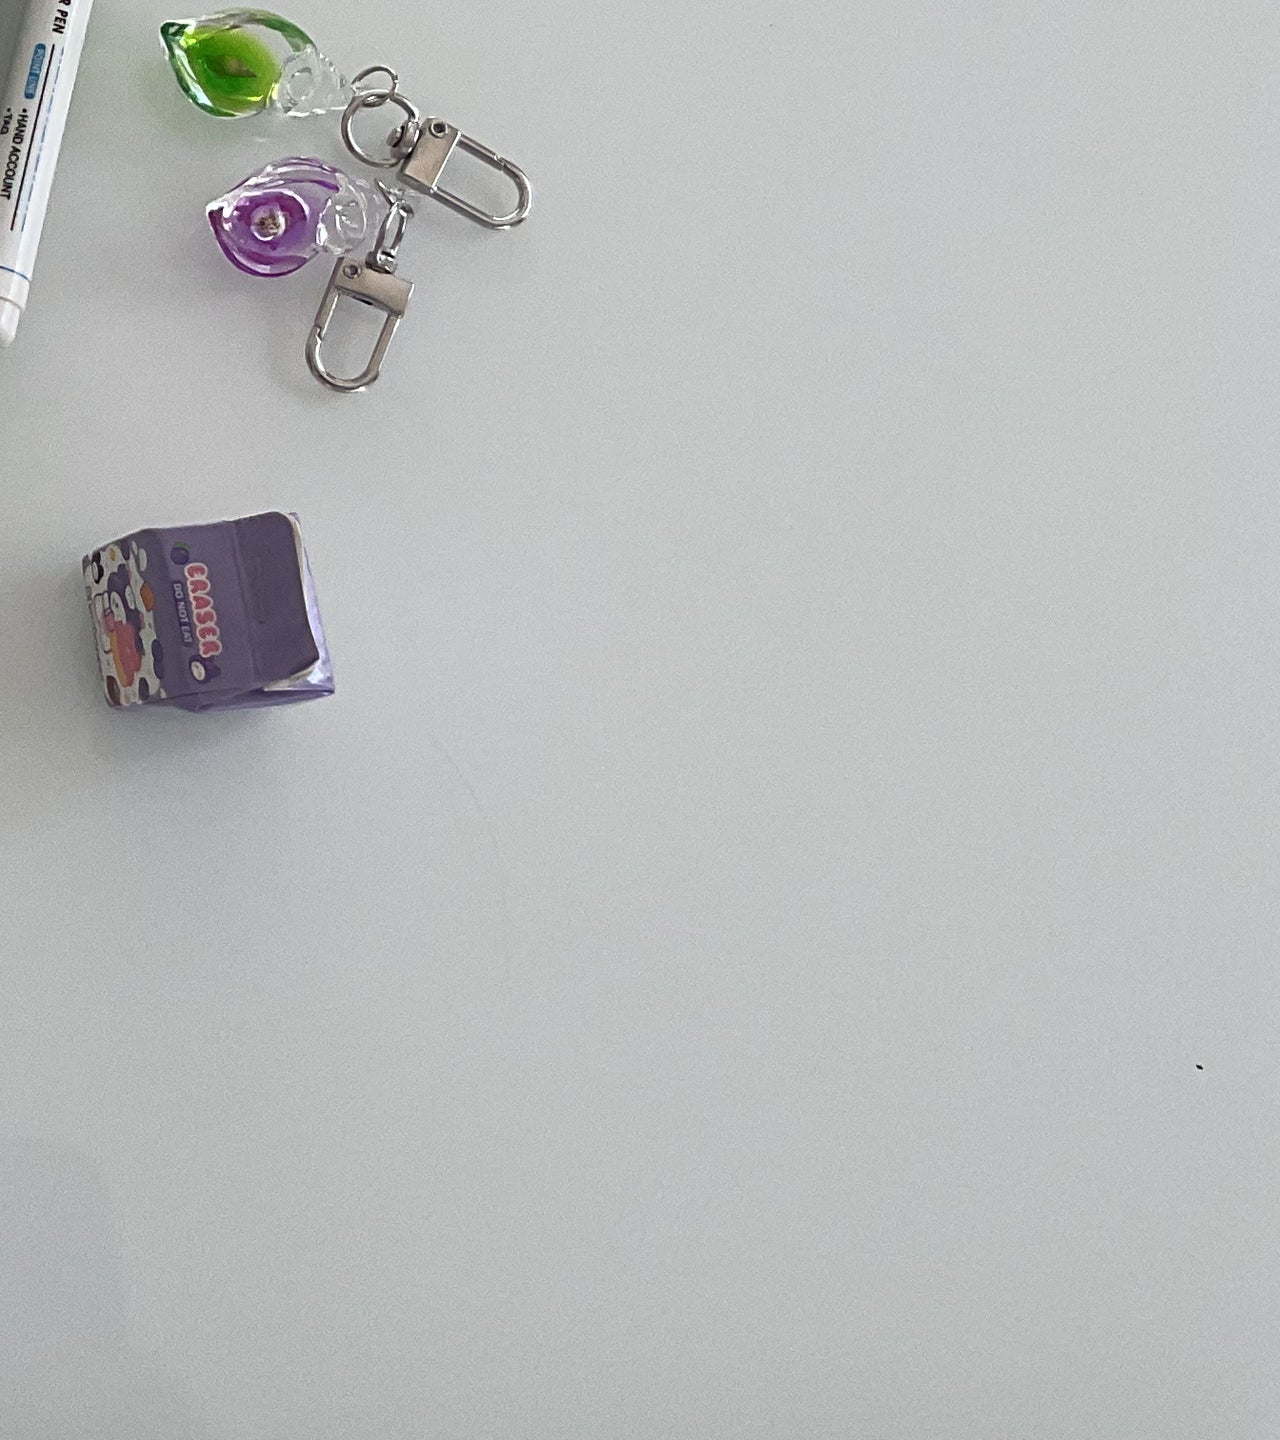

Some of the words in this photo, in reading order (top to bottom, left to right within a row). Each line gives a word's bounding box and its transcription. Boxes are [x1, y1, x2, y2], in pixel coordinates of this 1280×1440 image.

[52, 9, 69, 35] PEN
[0, 113, 12, 136] TAG
[12, 113, 29, 145] HAND
[0, 146, 21, 200] ACCOUNT
[173, 582, 184, 599] DO
[176, 601, 188, 623] NOT
[184, 561, 223, 658] ERASER
[181, 625, 192, 644] EAT
